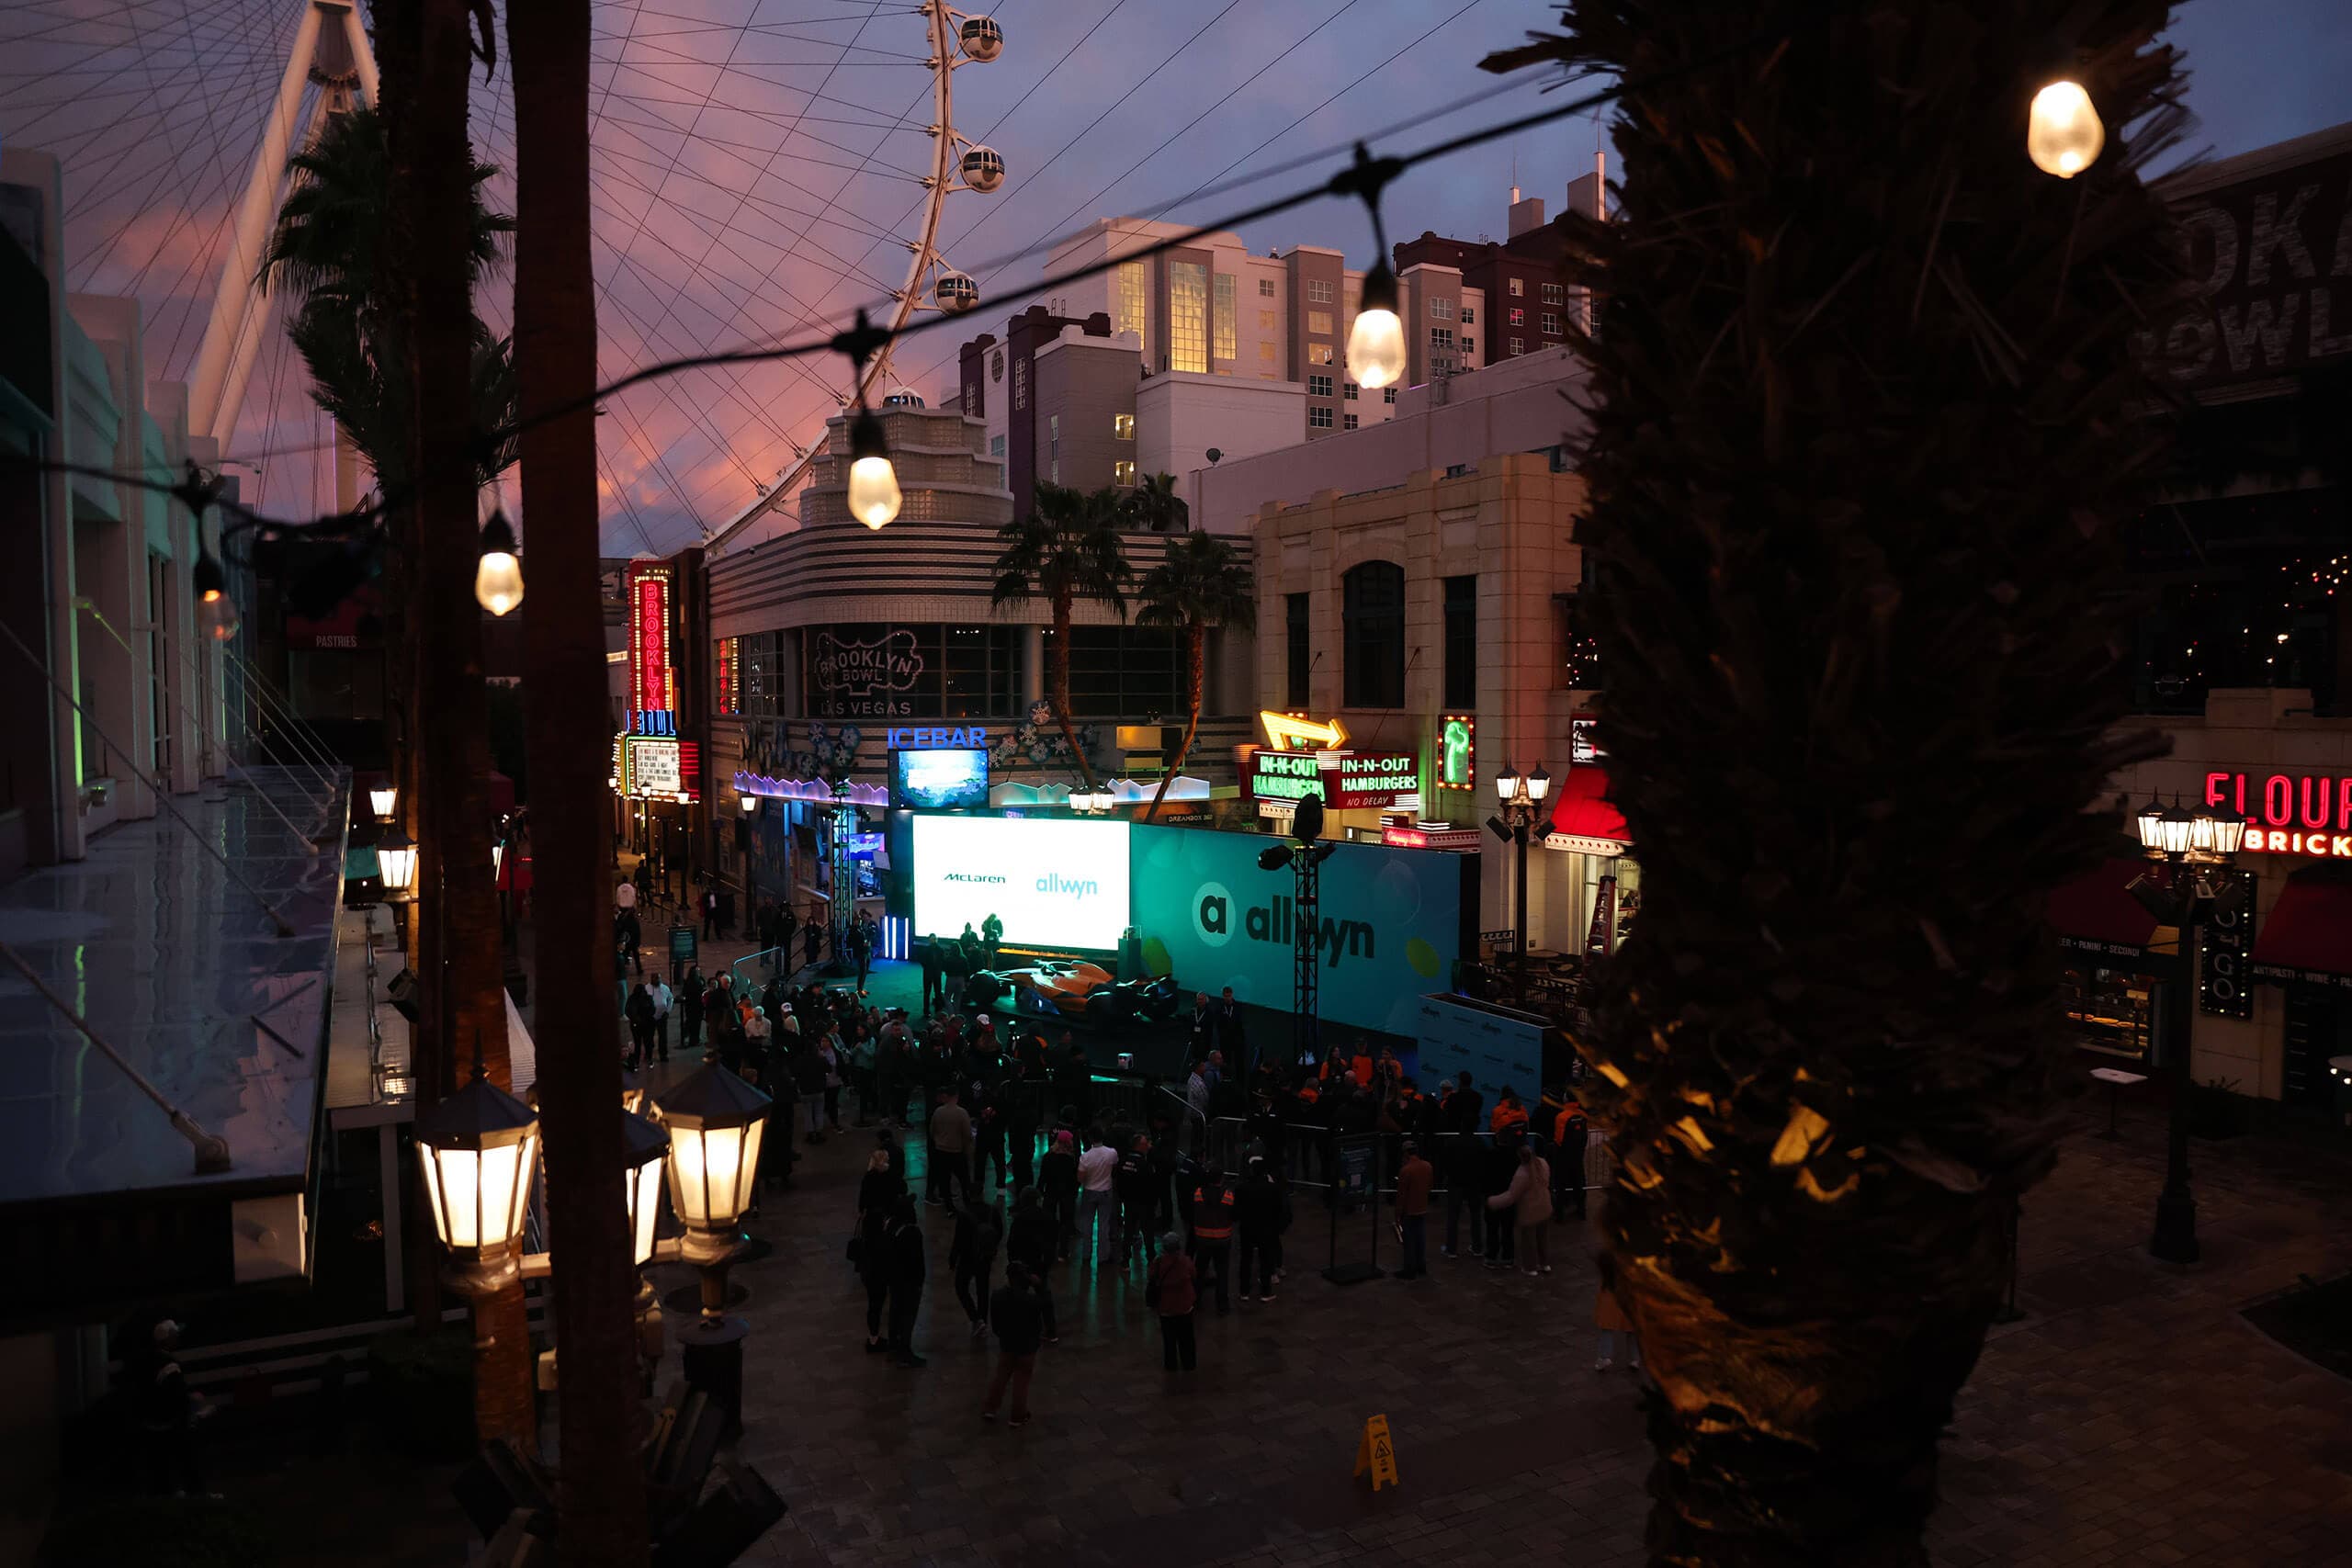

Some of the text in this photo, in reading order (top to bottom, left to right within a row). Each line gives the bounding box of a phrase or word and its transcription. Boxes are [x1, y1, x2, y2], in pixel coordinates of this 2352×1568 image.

[316, 635, 357, 648] PASTRIES
[645, 583, 660, 711] BROOKLYN
[820, 649, 912, 677] BROOKLYN
[842, 669, 883, 682] BOWL
[851, 702, 911, 715] VEGAS
[638, 709, 676, 735] BOWL
[888, 726, 987, 749] ICEBAR
[1261, 756, 1317, 777] IN-N-OUT
[1341, 758, 1411, 773] IN-N-OUT
[1341, 775, 1417, 792] HAMBURGERS
[1347, 795, 1389, 807] NO DELAY
[2245, 829, 2352, 858] BRICK
[944, 873, 1098, 900] McLaren allwyn
[2078, 940, 2102, 952] PANINI
[2109, 944, 2140, 957] SECONDI
